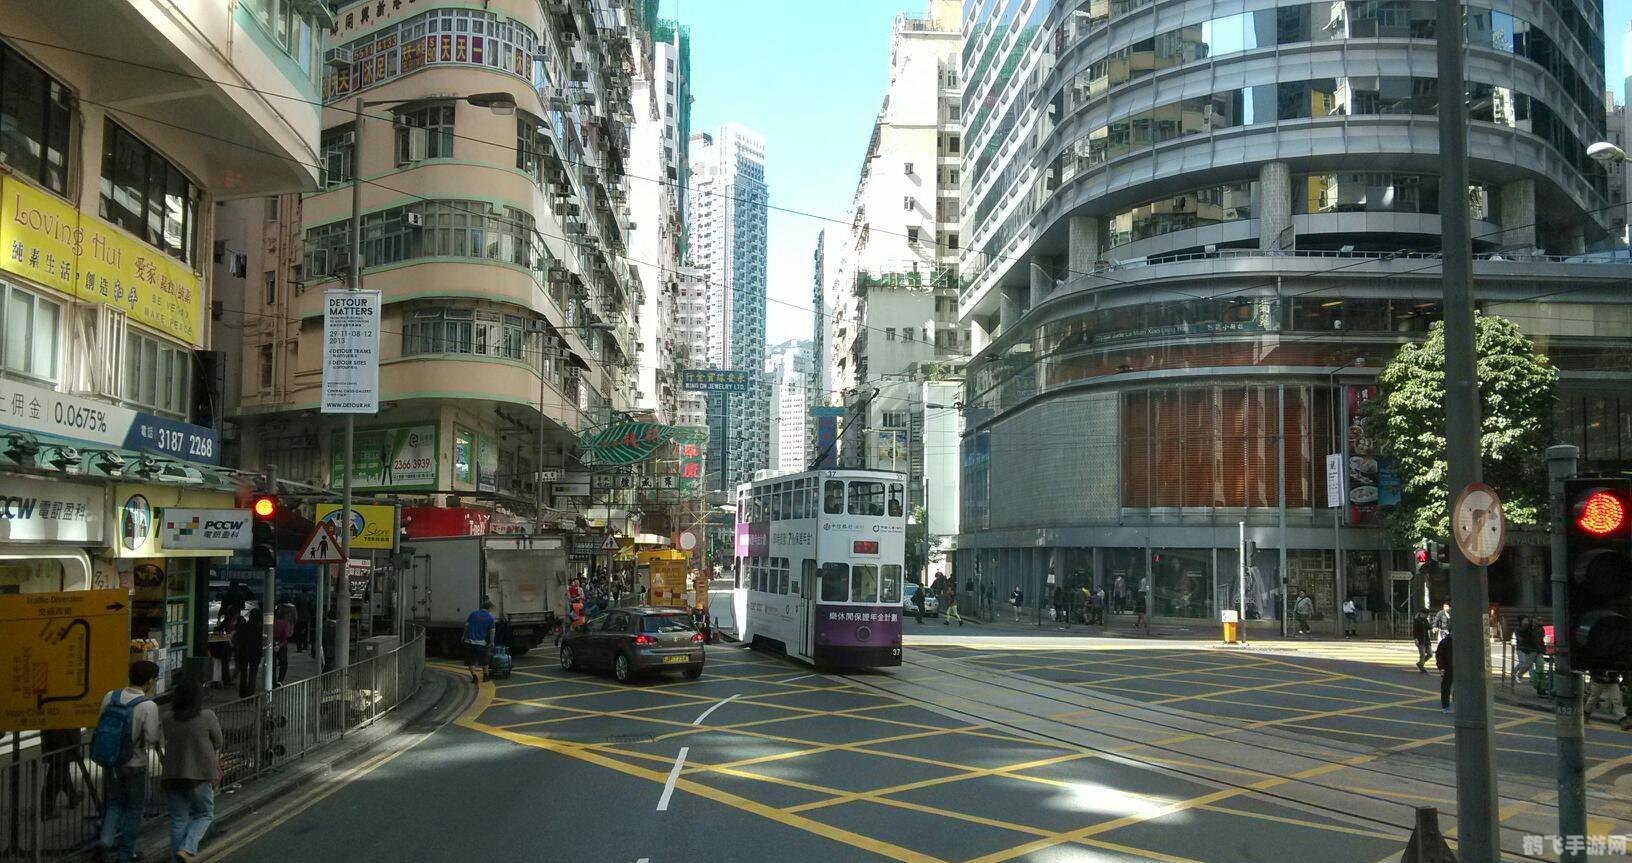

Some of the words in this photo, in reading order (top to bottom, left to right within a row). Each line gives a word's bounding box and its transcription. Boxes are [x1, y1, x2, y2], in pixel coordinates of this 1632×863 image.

[14, 195, 84, 257] Loving
[92, 232, 122, 269] Hut
[329, 298, 368, 307] DETOUR
[329, 307, 374, 316] MATTERS
[707, 382, 733, 390] JEWELRY
[54, 401, 107, 433] 0.0675%
[158, 428, 184, 452] 3187
[189, 434, 213, 458] 2268
[394, 459, 411, 470] 2366
[412, 457, 431, 469] 3939
[38, 500, 86, 521] 電訊盈科
[203, 520, 244, 530] PCCW
[203, 530, 240, 539] 電訊盈科
[892, 648, 901, 656] 37
